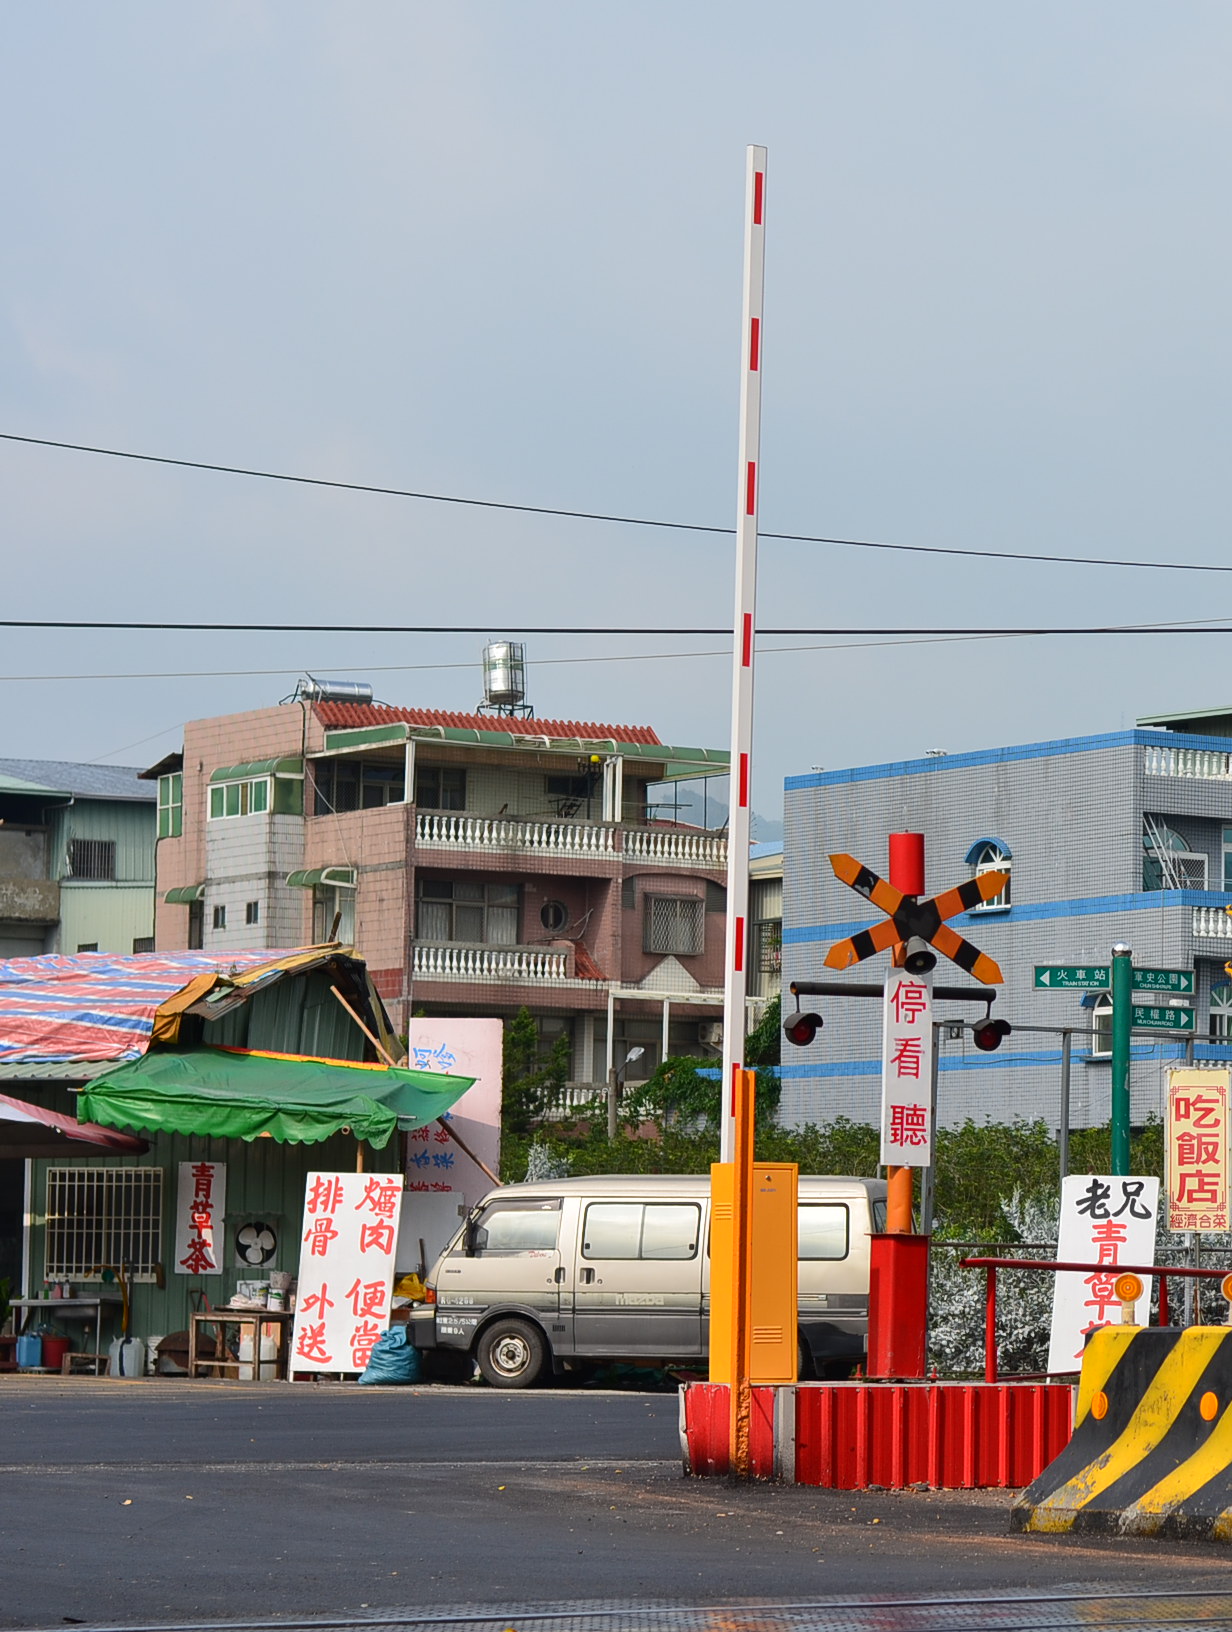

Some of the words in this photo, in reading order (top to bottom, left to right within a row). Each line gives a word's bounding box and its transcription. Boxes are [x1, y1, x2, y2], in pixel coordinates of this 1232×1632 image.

[1057, 969, 1106, 981] 火車站
[1134, 971, 1179, 985] 軍史公園
[1134, 1007, 1175, 1021] 民權路
[890, 980, 927, 1147] 停看聽
[1174, 1094, 1221, 1204] 吃飯店
[180, 1162, 215, 1275] 青草茶
[304, 1175, 343, 1257] 排骨
[1076, 1178, 1152, 1220] 老兄
[1170, 1213, 1227, 1229] 經濟合菜
[296, 1282, 335, 1364] 外送
[345, 1278, 386, 1368] 便當
